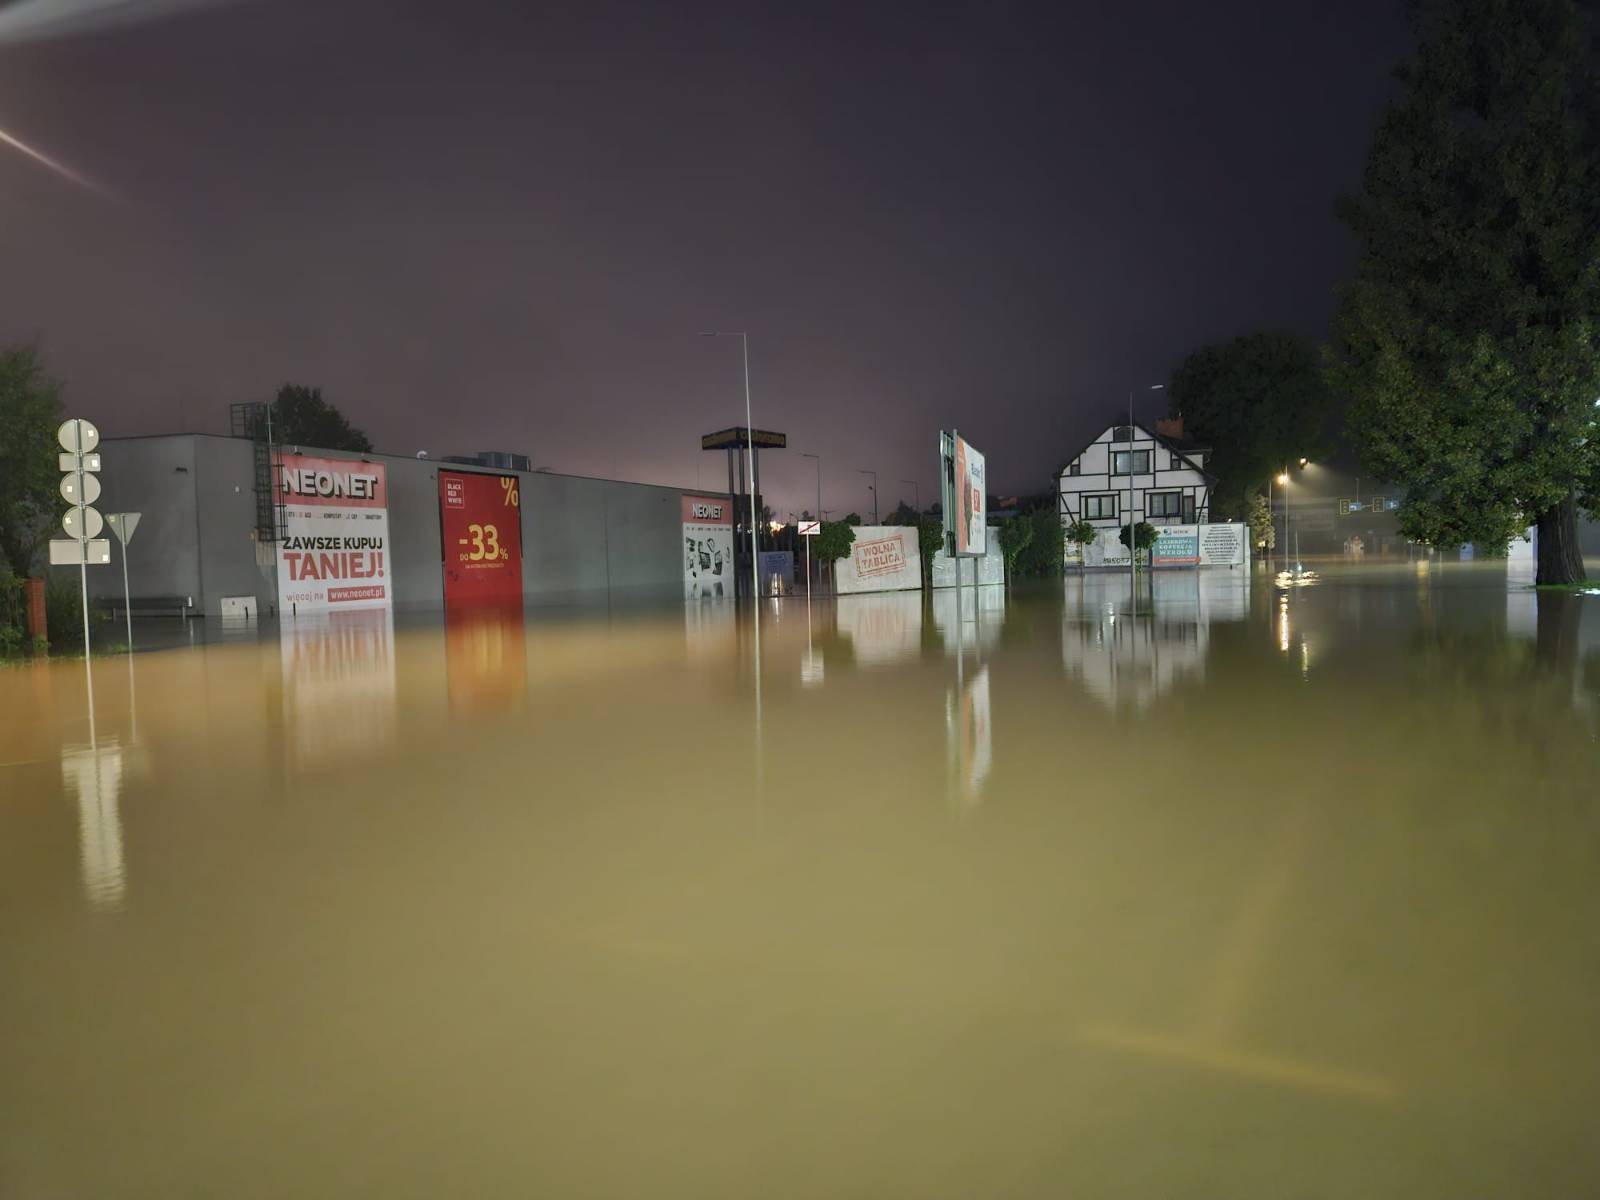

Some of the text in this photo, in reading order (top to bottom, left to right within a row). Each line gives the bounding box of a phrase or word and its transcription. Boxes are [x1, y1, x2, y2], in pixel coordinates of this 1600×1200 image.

[282, 467, 377, 499] NEONET
[692, 503, 722, 519] NEONET
[283, 536, 383, 550] ZAWSZE KUPUJ
[863, 543, 896, 557] WOLNA
[283, 551, 385, 581] TANIEJ!
[861, 553, 900, 569] TABLICA
[330, 588, 383, 600] www.neonet.pl
